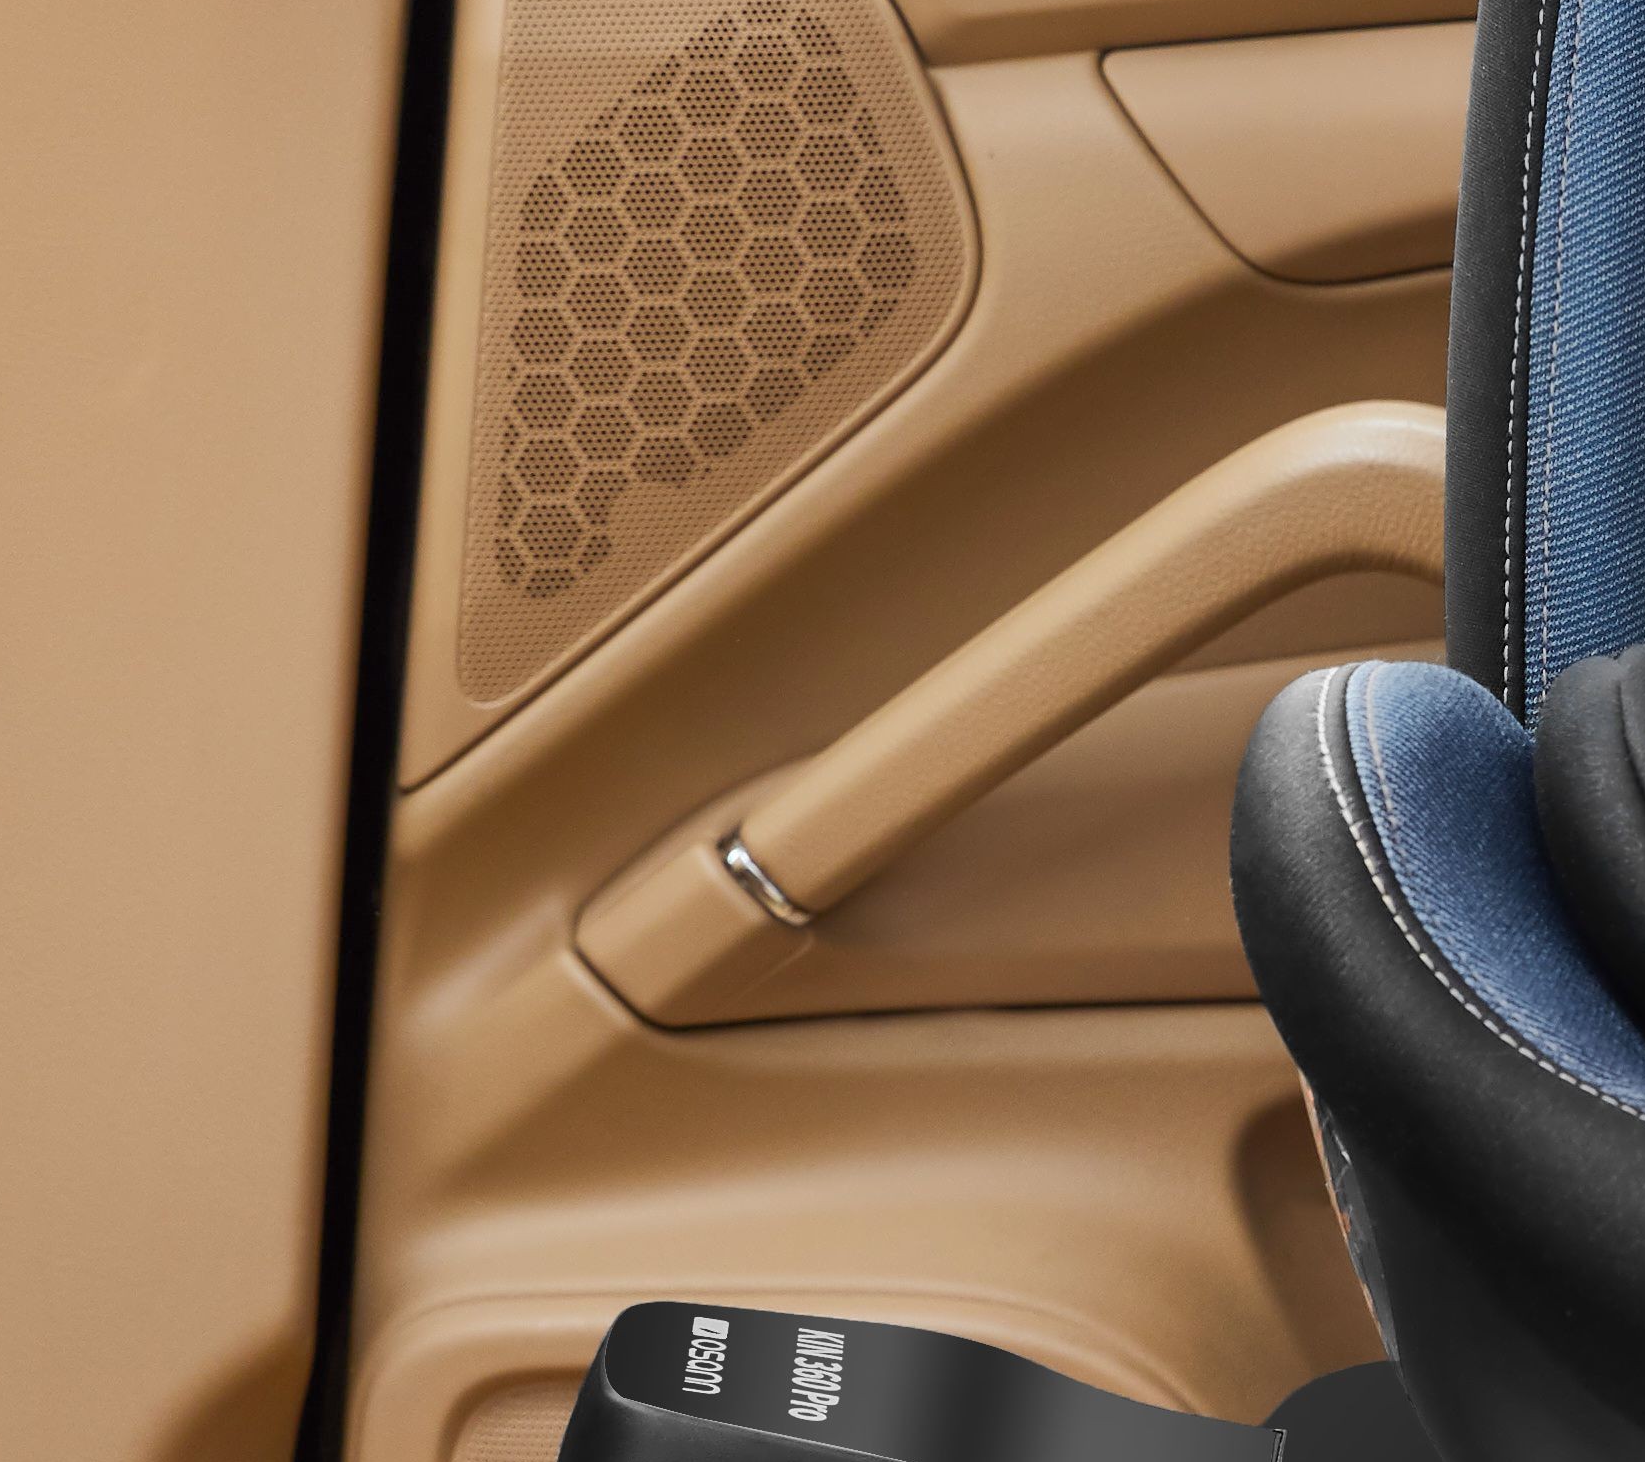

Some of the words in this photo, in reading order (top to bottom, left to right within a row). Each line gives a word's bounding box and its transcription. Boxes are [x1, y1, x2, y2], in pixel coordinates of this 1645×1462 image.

[795, 1327, 845, 1361] KIN
[682, 1338, 728, 1396] osann
[791, 1356, 843, 1392] 360
[787, 1388, 840, 1422] Pro
